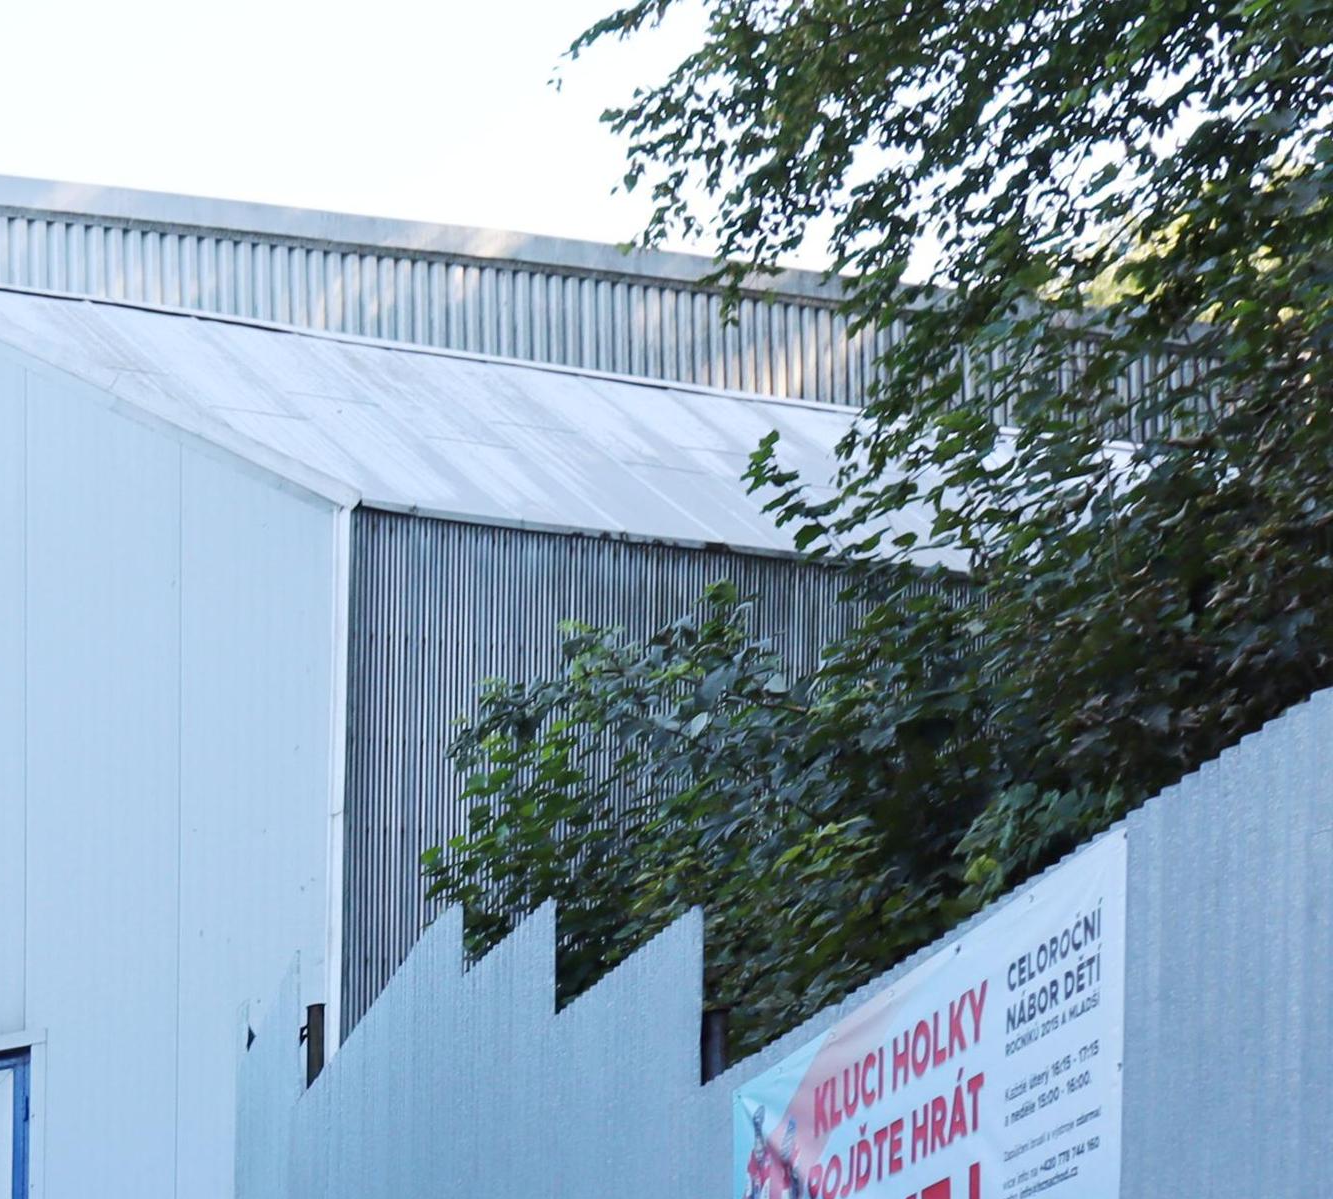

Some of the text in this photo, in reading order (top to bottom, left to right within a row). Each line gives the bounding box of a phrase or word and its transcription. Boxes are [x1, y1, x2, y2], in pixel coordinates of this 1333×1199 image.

[1005, 943, 1102, 1035] NÁBOR DĚTÍ
[1007, 897, 1102, 992] CELOROČNÍ
[813, 979, 988, 1139] KLUCI HOLKY
[911, 1067, 985, 1164] HRÁT
